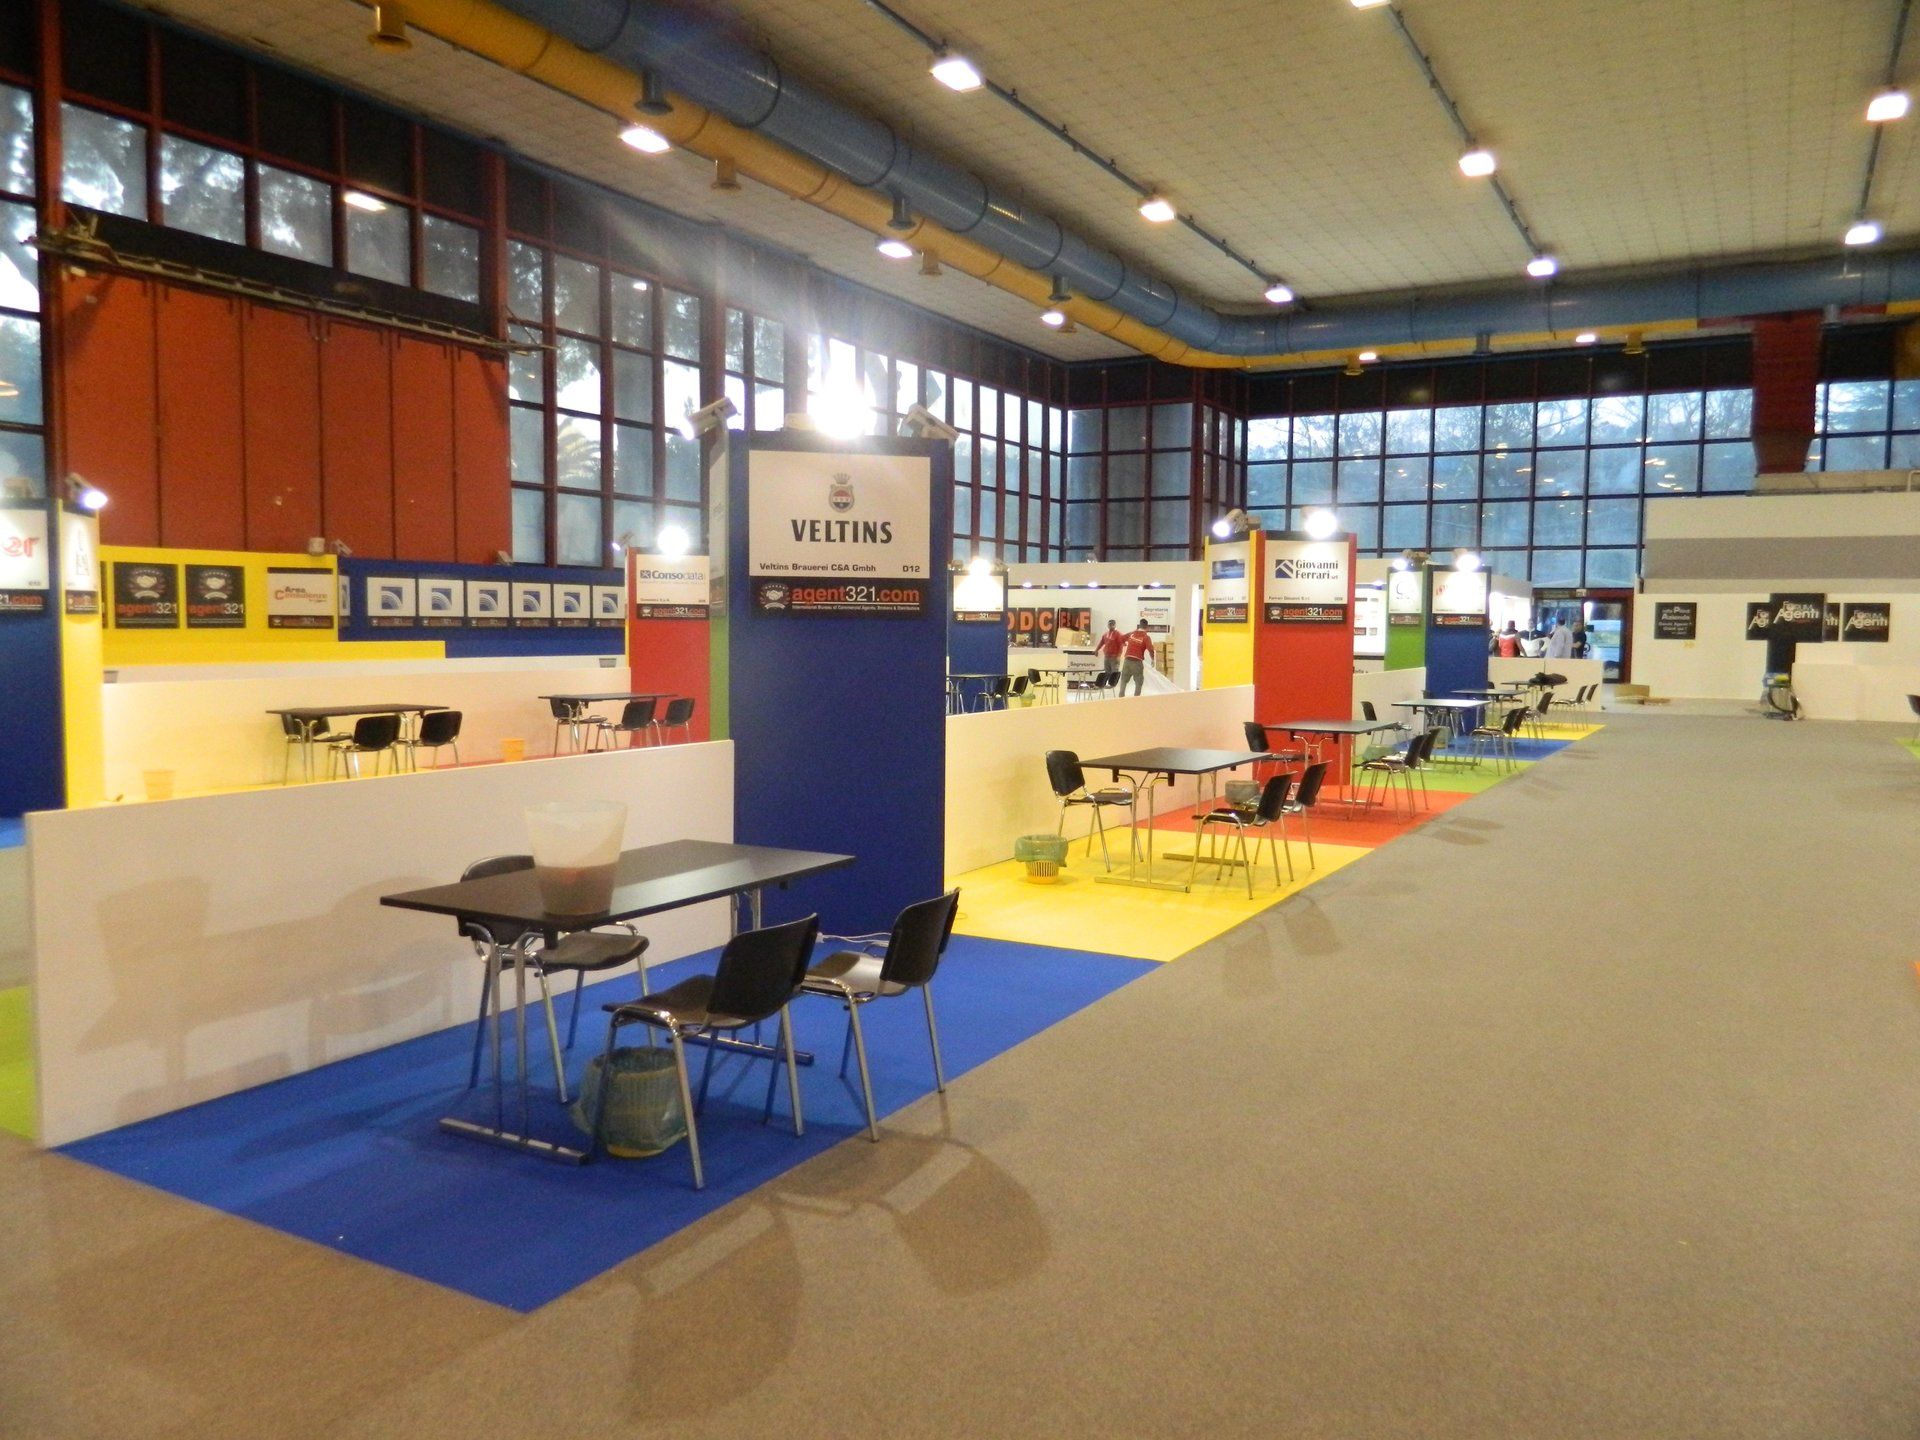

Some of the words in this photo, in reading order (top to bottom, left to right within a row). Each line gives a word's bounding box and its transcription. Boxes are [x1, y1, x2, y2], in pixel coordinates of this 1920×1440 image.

[791, 519, 893, 544] VELTINS
[759, 562, 790, 571] Veltins
[792, 563, 829, 572] Brauerei
[831, 564, 850, 572] C&A
[852, 564, 876, 572] Gmbh
[1296, 559, 1339, 570] Giovanni
[652, 570, 704, 581] Consodata
[1296, 570, 1330, 579] Ferrari
[791, 585, 920, 607] agent321.com
[1283, 607, 1343, 617] agent321.com
[1020, 611, 1034, 631] D
[1038, 611, 1053, 632] C
